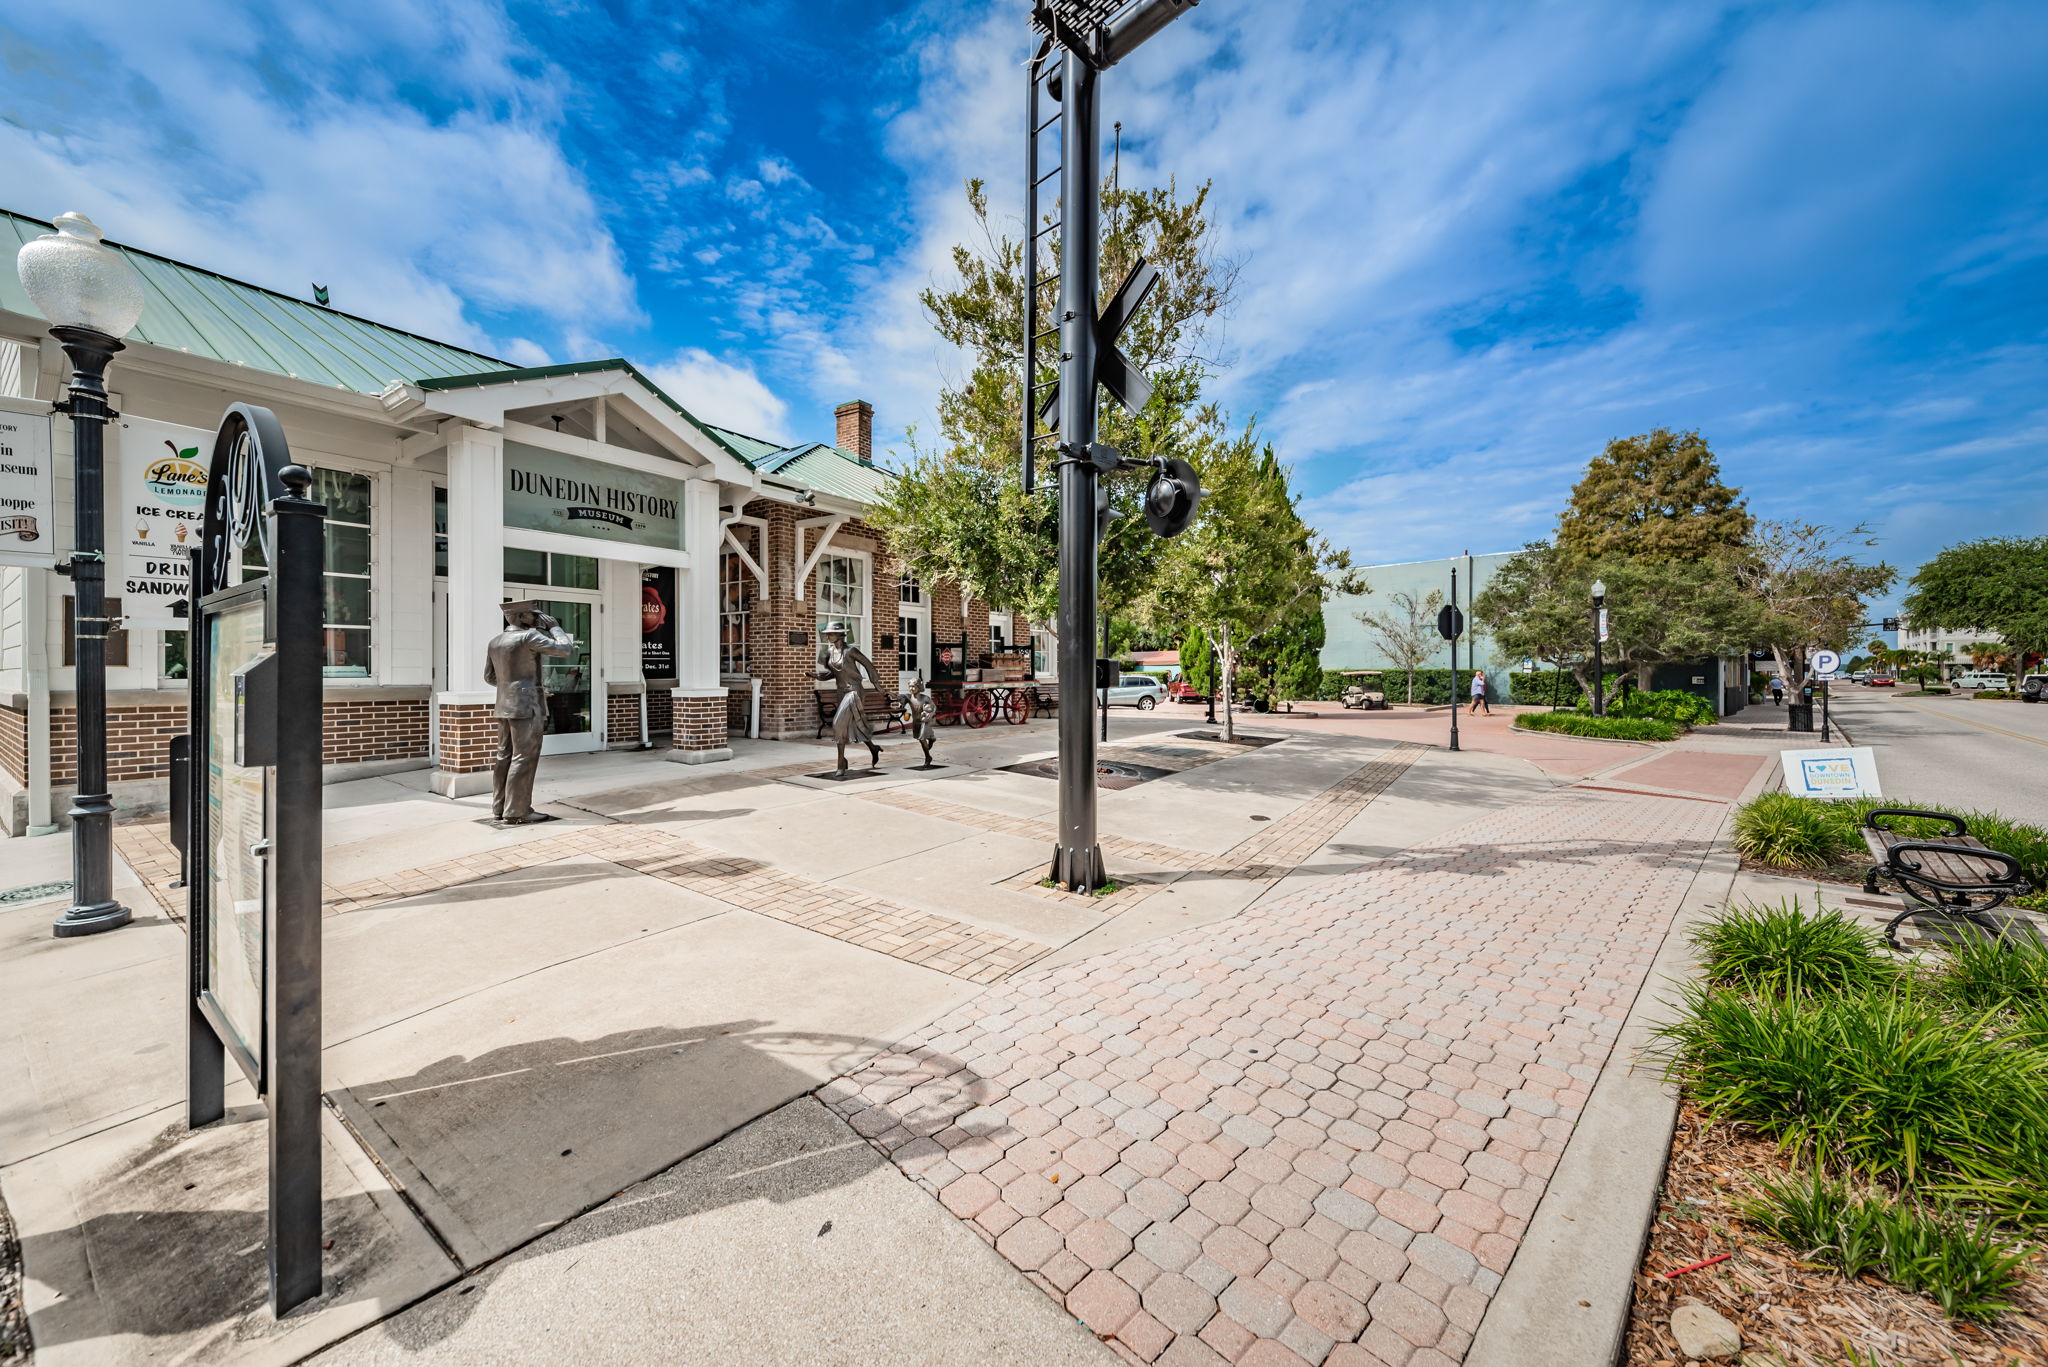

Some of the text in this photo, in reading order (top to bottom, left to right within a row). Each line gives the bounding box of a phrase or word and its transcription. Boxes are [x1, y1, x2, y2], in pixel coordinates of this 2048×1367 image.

[148, 464, 208, 486] Lane's
[510, 469, 679, 520] DUNEDIN HISTORY
[136, 506, 161, 517] ICE
[578, 509, 624, 524] MUSEUM
[146, 562, 189, 577] DRIN
[126, 580, 189, 596] SANDW
[1819, 655, 1832, 669] P
